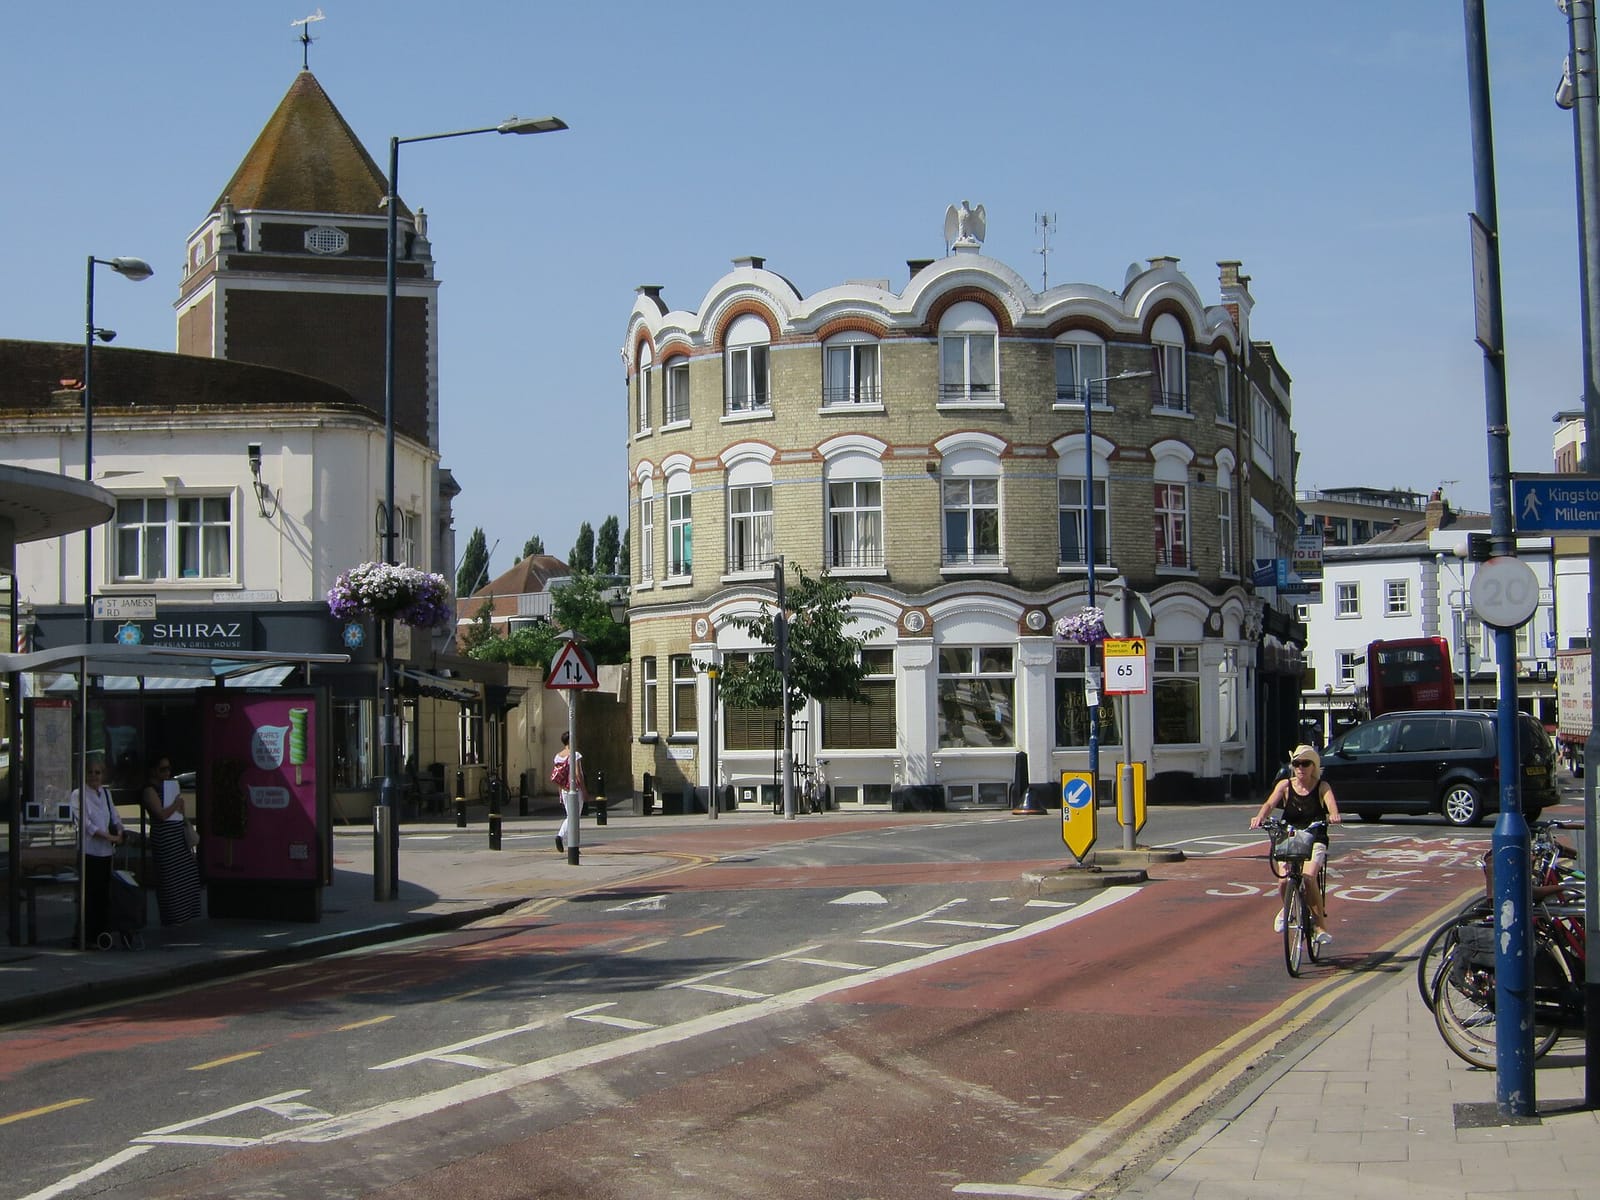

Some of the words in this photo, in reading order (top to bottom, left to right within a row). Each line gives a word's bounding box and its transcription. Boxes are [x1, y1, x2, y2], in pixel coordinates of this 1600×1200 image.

[1549, 488, 1600, 504] Kingsto
[1295, 550, 1305, 559] TO
[1308, 550, 1321, 559] LET
[1483, 579, 1527, 606] 20
[106, 599, 118, 608] ST
[120, 599, 154, 608] JAMES'S
[106, 608, 120, 617] RD
[153, 623, 241, 638] SHIRAZ
[214, 640, 241, 648] HOUSE
[1117, 664, 1133, 676] 65
